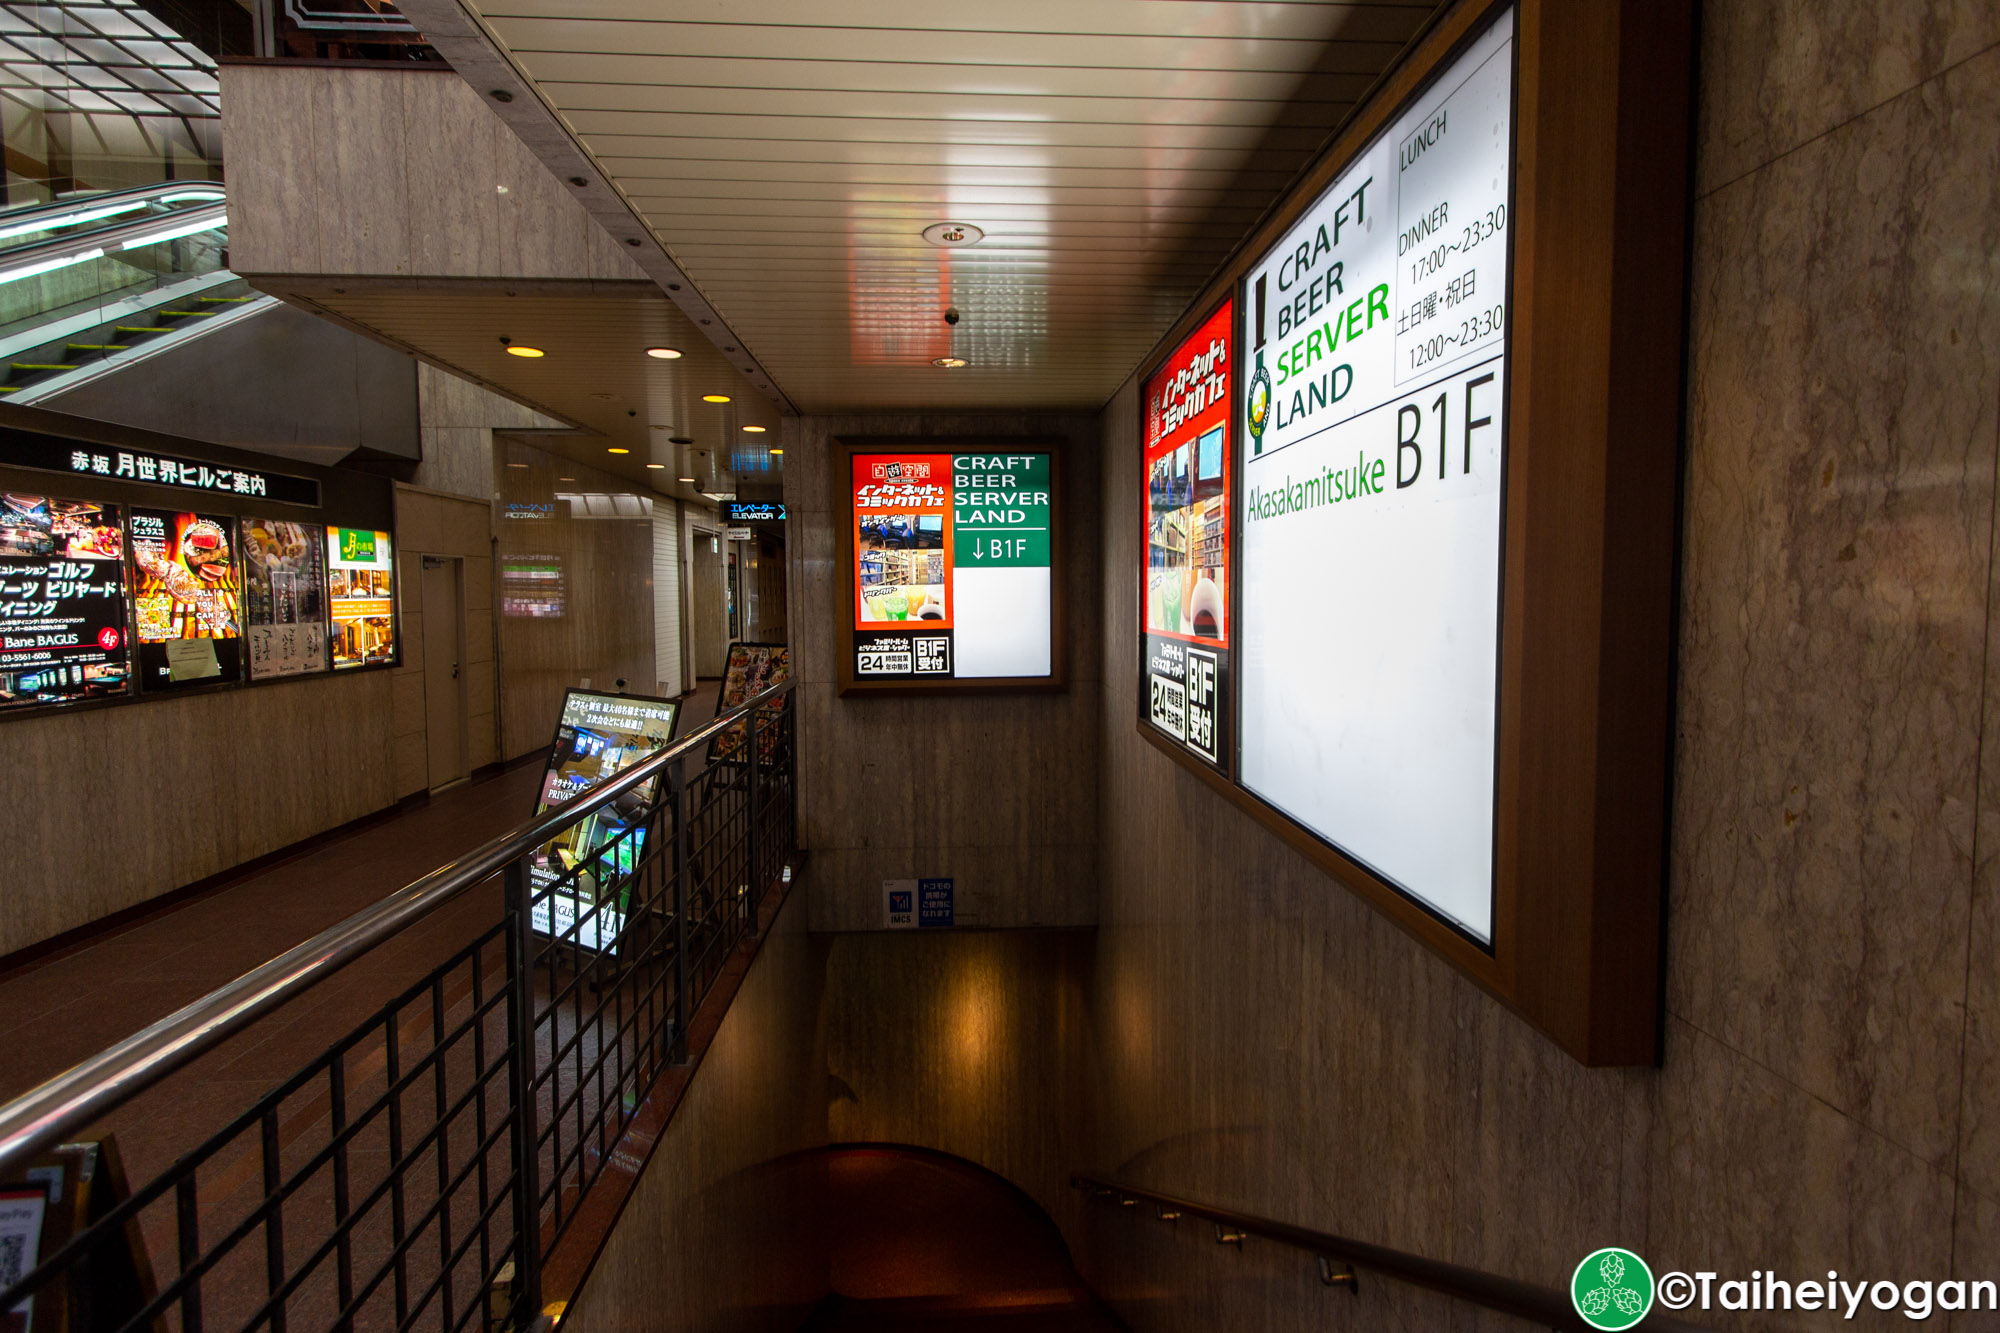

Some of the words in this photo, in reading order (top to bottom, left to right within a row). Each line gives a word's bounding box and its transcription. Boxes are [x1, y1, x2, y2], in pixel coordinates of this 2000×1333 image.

[1401, 110, 1447, 172] LUNCH
[1279, 176, 1373, 292] CRAFT
[1398, 201, 1448, 256] DINNER
[1279, 260, 1344, 341] BEER
[1396, 268, 1475, 336] 土日曜・祝日
[1276, 282, 1390, 386] SERVER
[1276, 363, 1354, 431] LAND
[1161, 372, 1226, 439] コミックカフェ
[1248, 451, 1385, 523] Akasakamitsuke
[1396, 372, 1495, 490] B1F
[872, 463, 930, 479] 自遊空間
[954, 456, 1036, 470] CRAFT
[71, 451, 110, 475] 赤坂
[115, 452, 266, 496] 月世界ビルご案内
[955, 474, 1016, 488] BEER
[857, 495, 945, 507] コミックカフェ
[954, 492, 1049, 506] SERVER
[730, 504, 776, 513] エレベーター
[732, 512, 774, 520] ELEVATOR
[132, 516, 164, 528] ブラジル
[955, 510, 1026, 524] LAND
[133, 526, 165, 536] シュラスコ
[990, 538, 1027, 559] B1F
[0, 564, 48, 576] ュレーション
[48, 562, 95, 579] ゴルフ
[46, 581, 117, 598] ビリヤード
[196, 589, 213, 597] ALL
[863, 586, 898, 598] ドリンクバー
[0, 600, 58, 617] イニング
[198, 623, 215, 631] EAT
[5, 637, 36, 648] Bane
[37, 633, 79, 647] BAGUS
[101, 630, 118, 647] 4F
[917, 640, 945, 657] B1F
[2, 652, 52, 662] 03-5561-6006
[861, 655, 884, 671] 24
[918, 657, 944, 671] 受付
[885, 663, 908, 671] 年中無休
[1189, 656, 1214, 706] B1F
[1153, 681, 1166, 723] 24
[1189, 703, 1212, 749] 受付
[530, 865, 561, 882] imulation
[923, 882, 951, 890] ドコモの
[890, 915, 911, 923] IMCS
